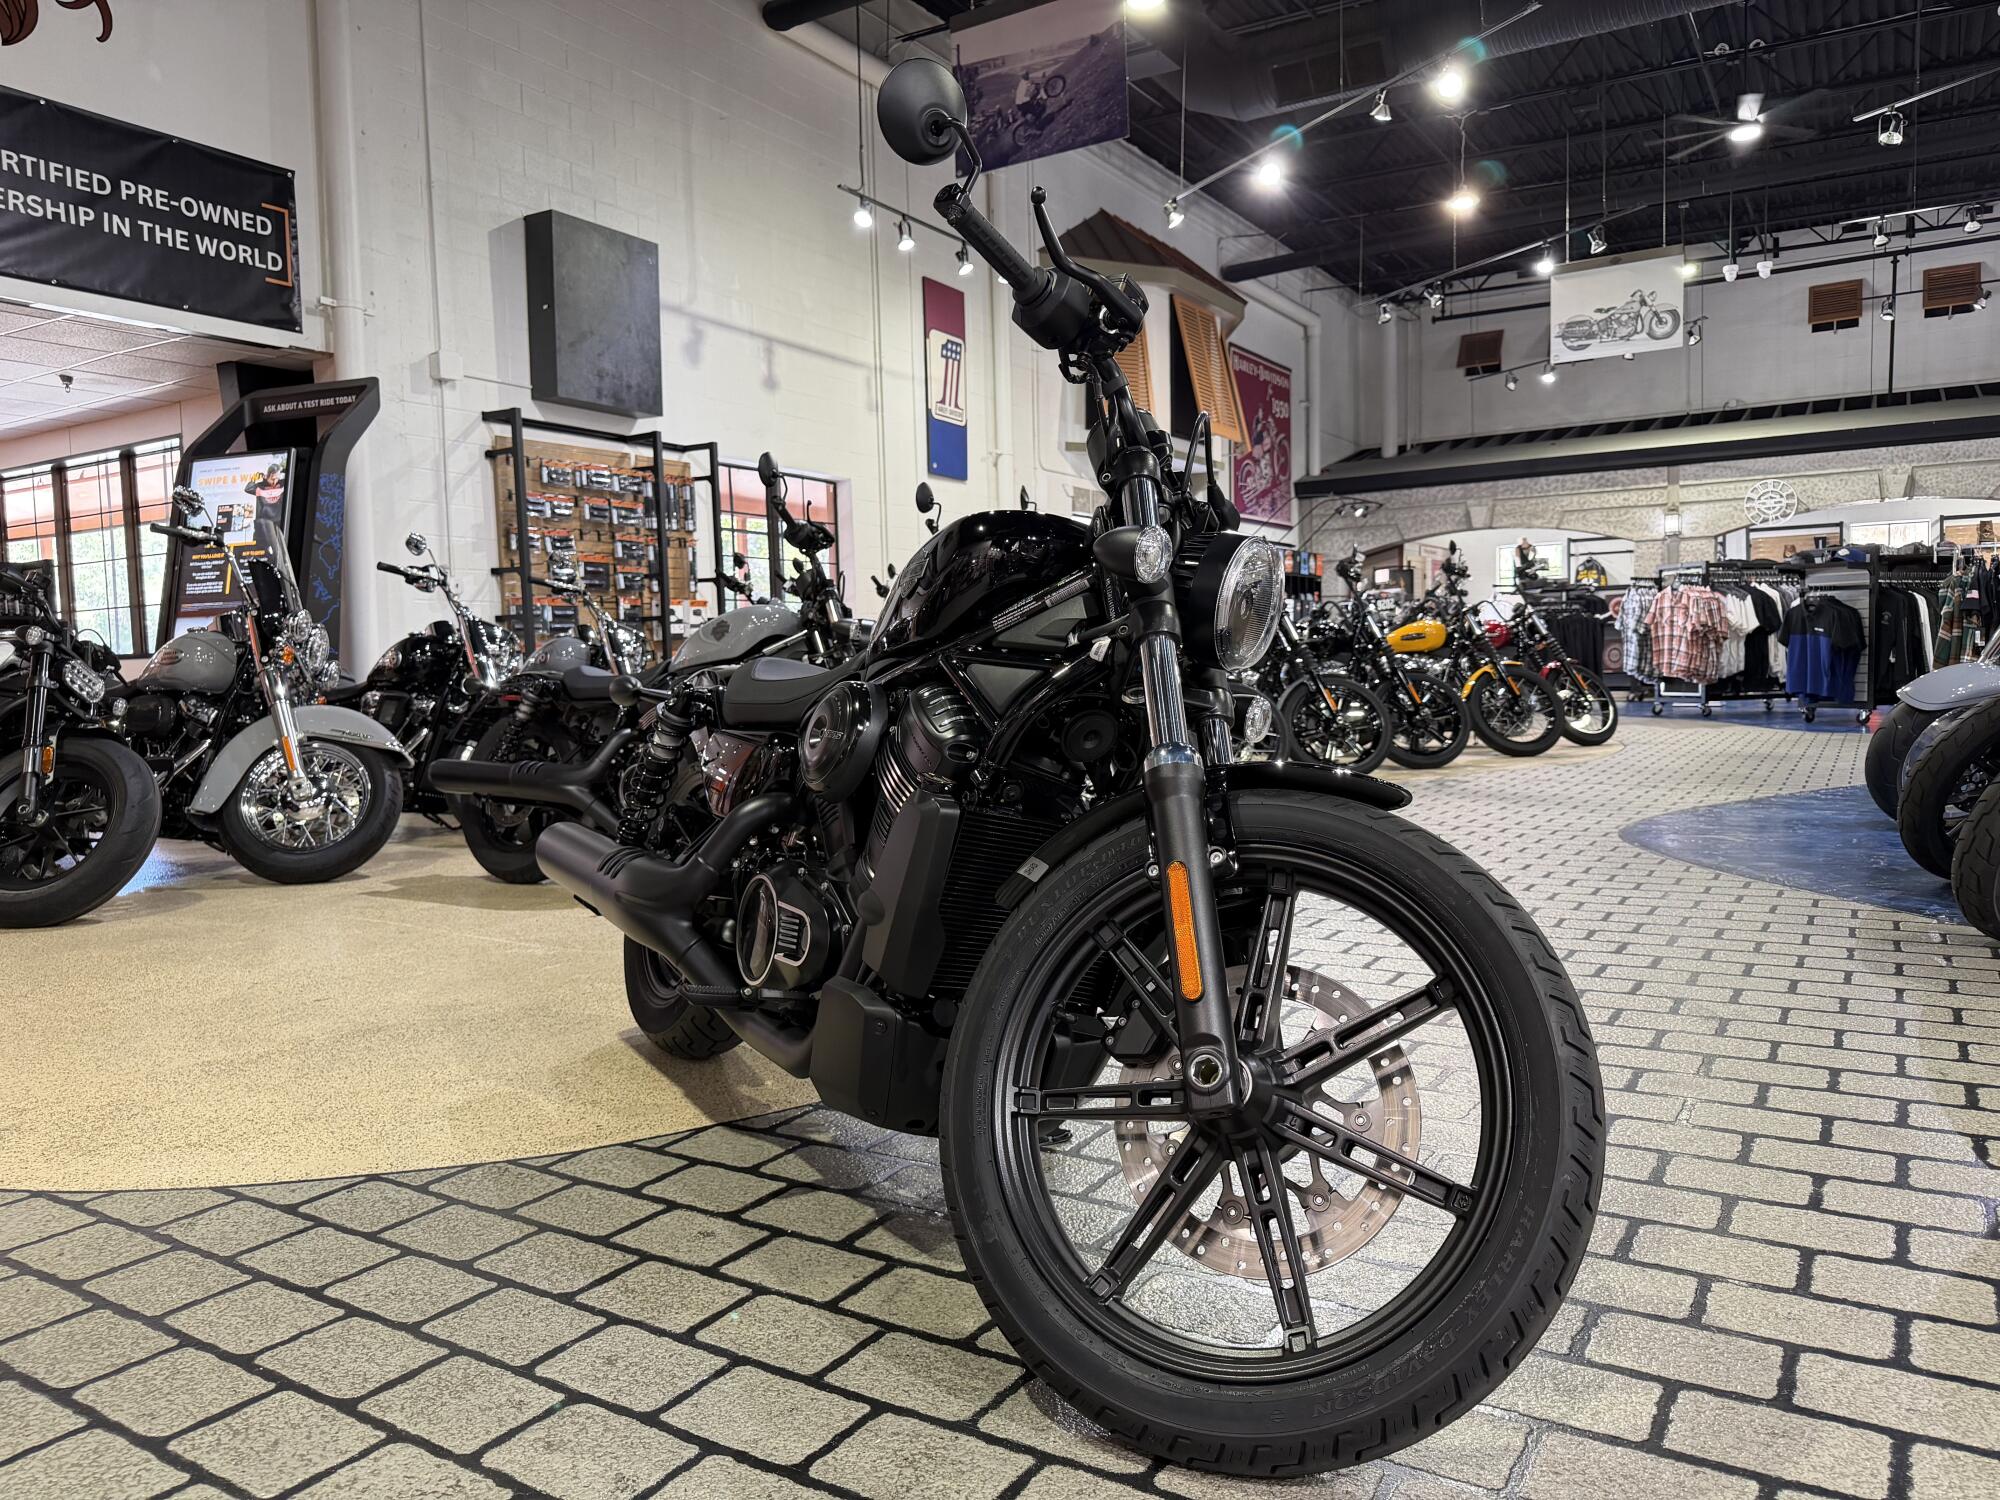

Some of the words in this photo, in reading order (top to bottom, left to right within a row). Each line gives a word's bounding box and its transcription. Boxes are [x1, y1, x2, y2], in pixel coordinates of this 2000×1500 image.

[120, 179, 273, 236] PRE-OWNED
[103, 212, 131, 238] IN
[138, 220, 190, 251] THE
[195, 234, 283, 272] WORLD
[263, 404, 276, 413] ASK
[276, 401, 297, 412] ABOUT
[297, 401, 304, 409] A
[304, 399, 319, 409] TEST
[319, 397, 335, 407] RIDE
[335, 394, 357, 405] TODAY
[198, 474, 228, 487] SWIPE
